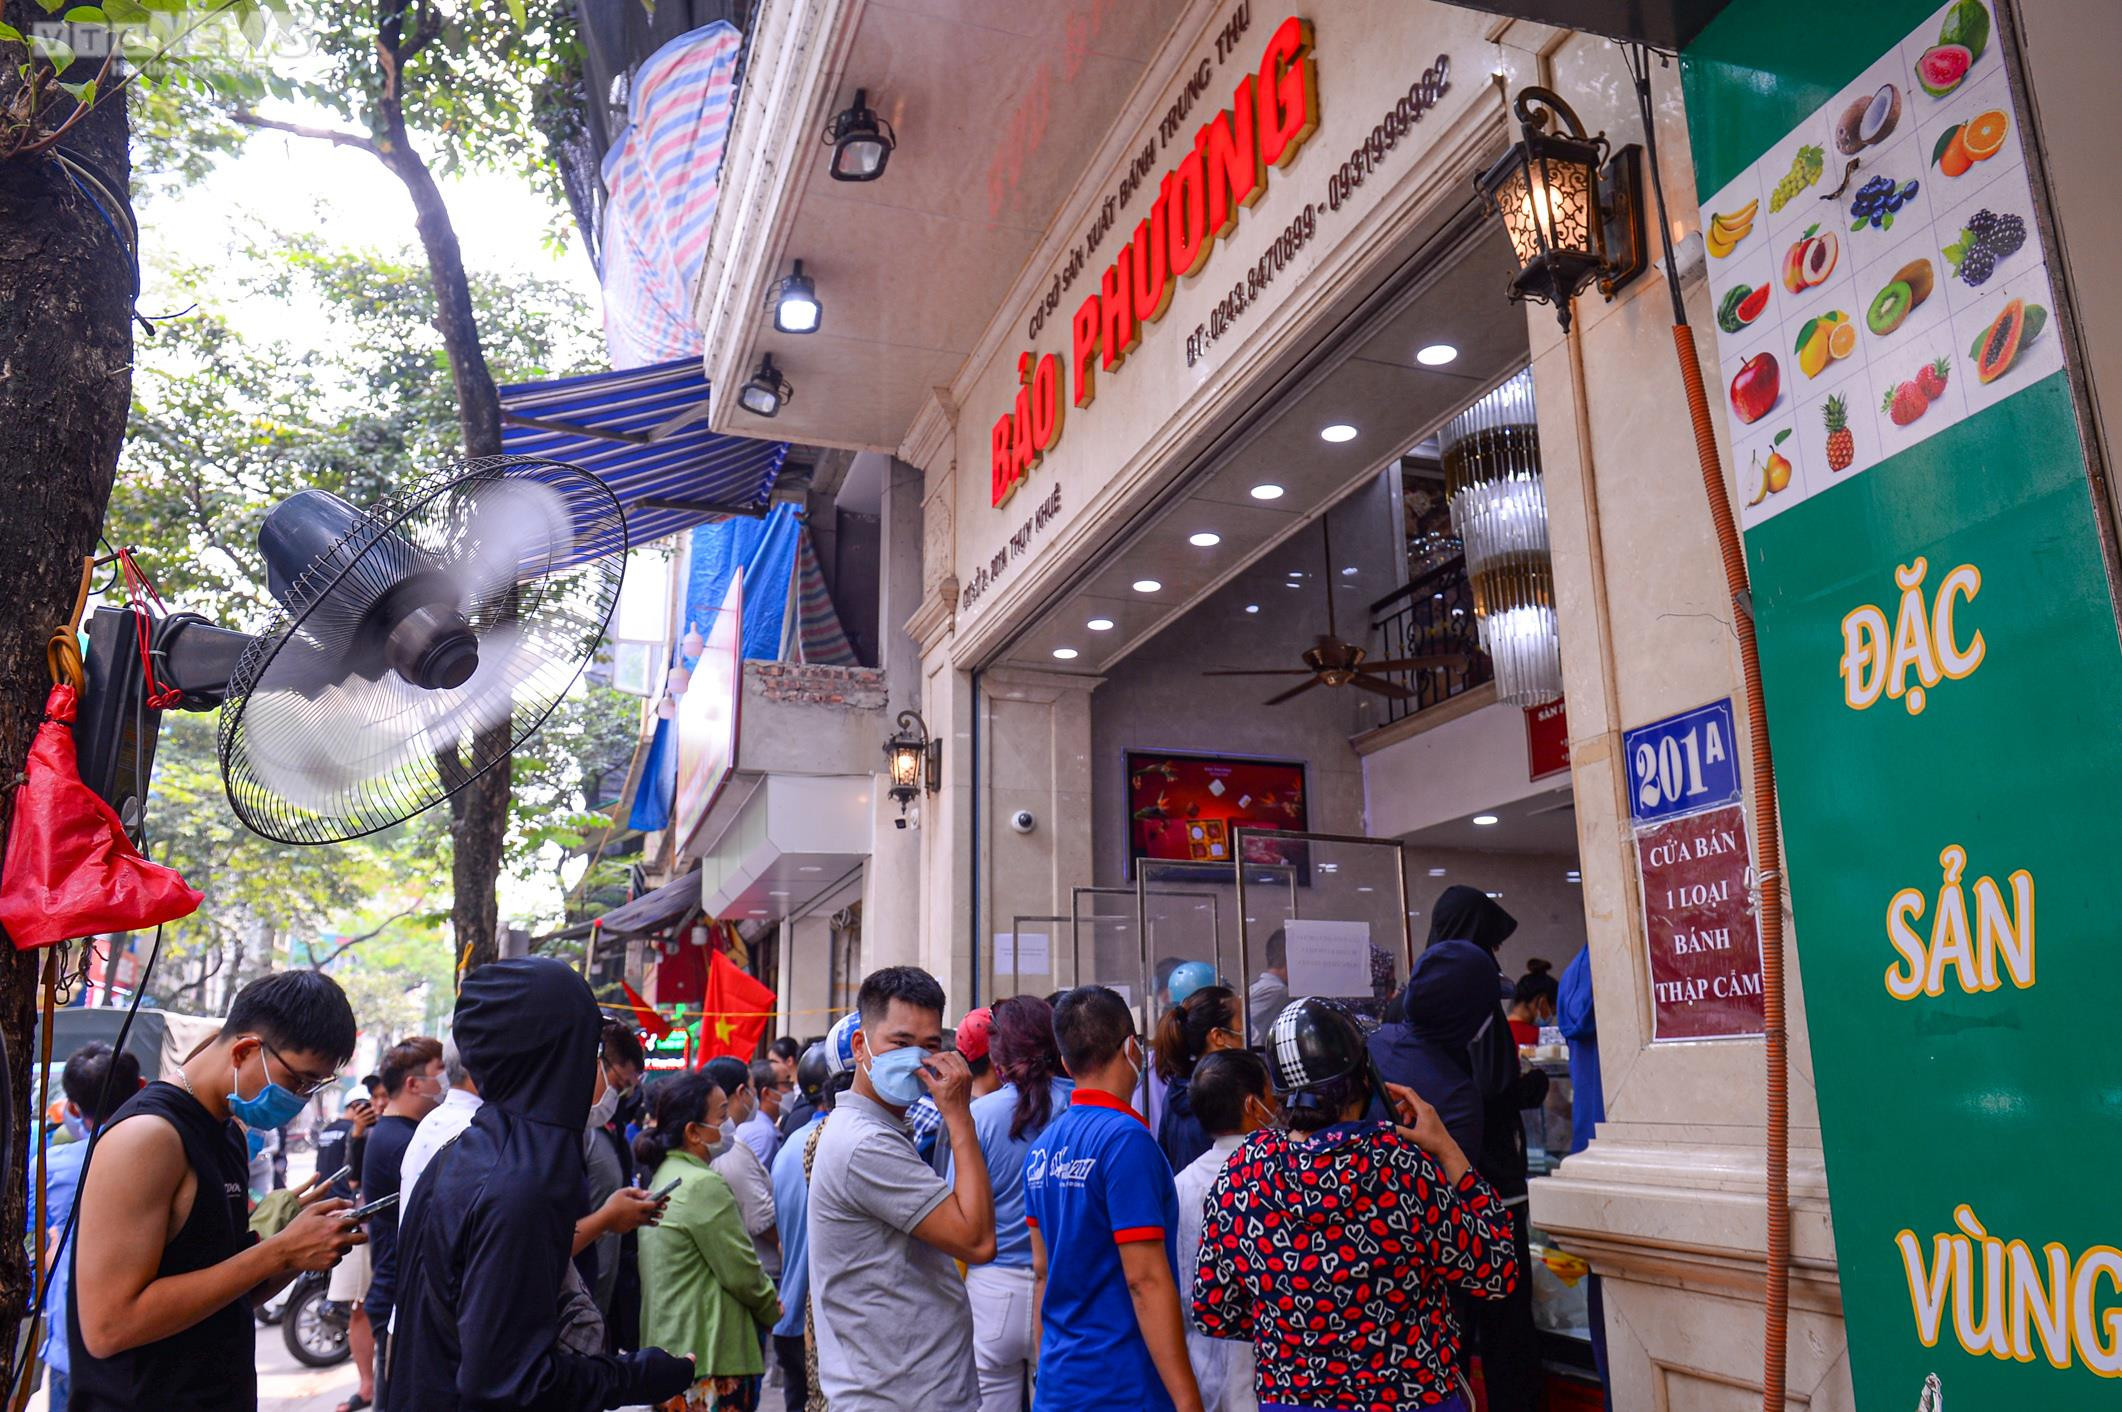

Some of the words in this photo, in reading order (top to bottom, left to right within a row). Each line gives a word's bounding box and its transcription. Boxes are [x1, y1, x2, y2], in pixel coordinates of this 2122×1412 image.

[1119, 137, 1157, 210] BÁNH
[1158, 57, 1213, 149] TRUNG
[1215, 0, 1251, 65] THU
[992, 351, 1065, 510] BẢO
[1073, 16, 1318, 410] PHƯƠNG
[1840, 556, 1986, 716] ĐẶC
[1636, 721, 1726, 809] 201A
[1650, 838, 1691, 867] CỬA
[1695, 829, 1736, 859] BÁN
[1666, 890, 1674, 910] 1
[1679, 880, 1729, 908] LOẠI
[1674, 927, 1731, 955] BÁNH
[1885, 844, 2036, 1001] SẢN
[1656, 977, 1708, 1006] THẬP
[1895, 1203, 2122, 1379] VÙNG
